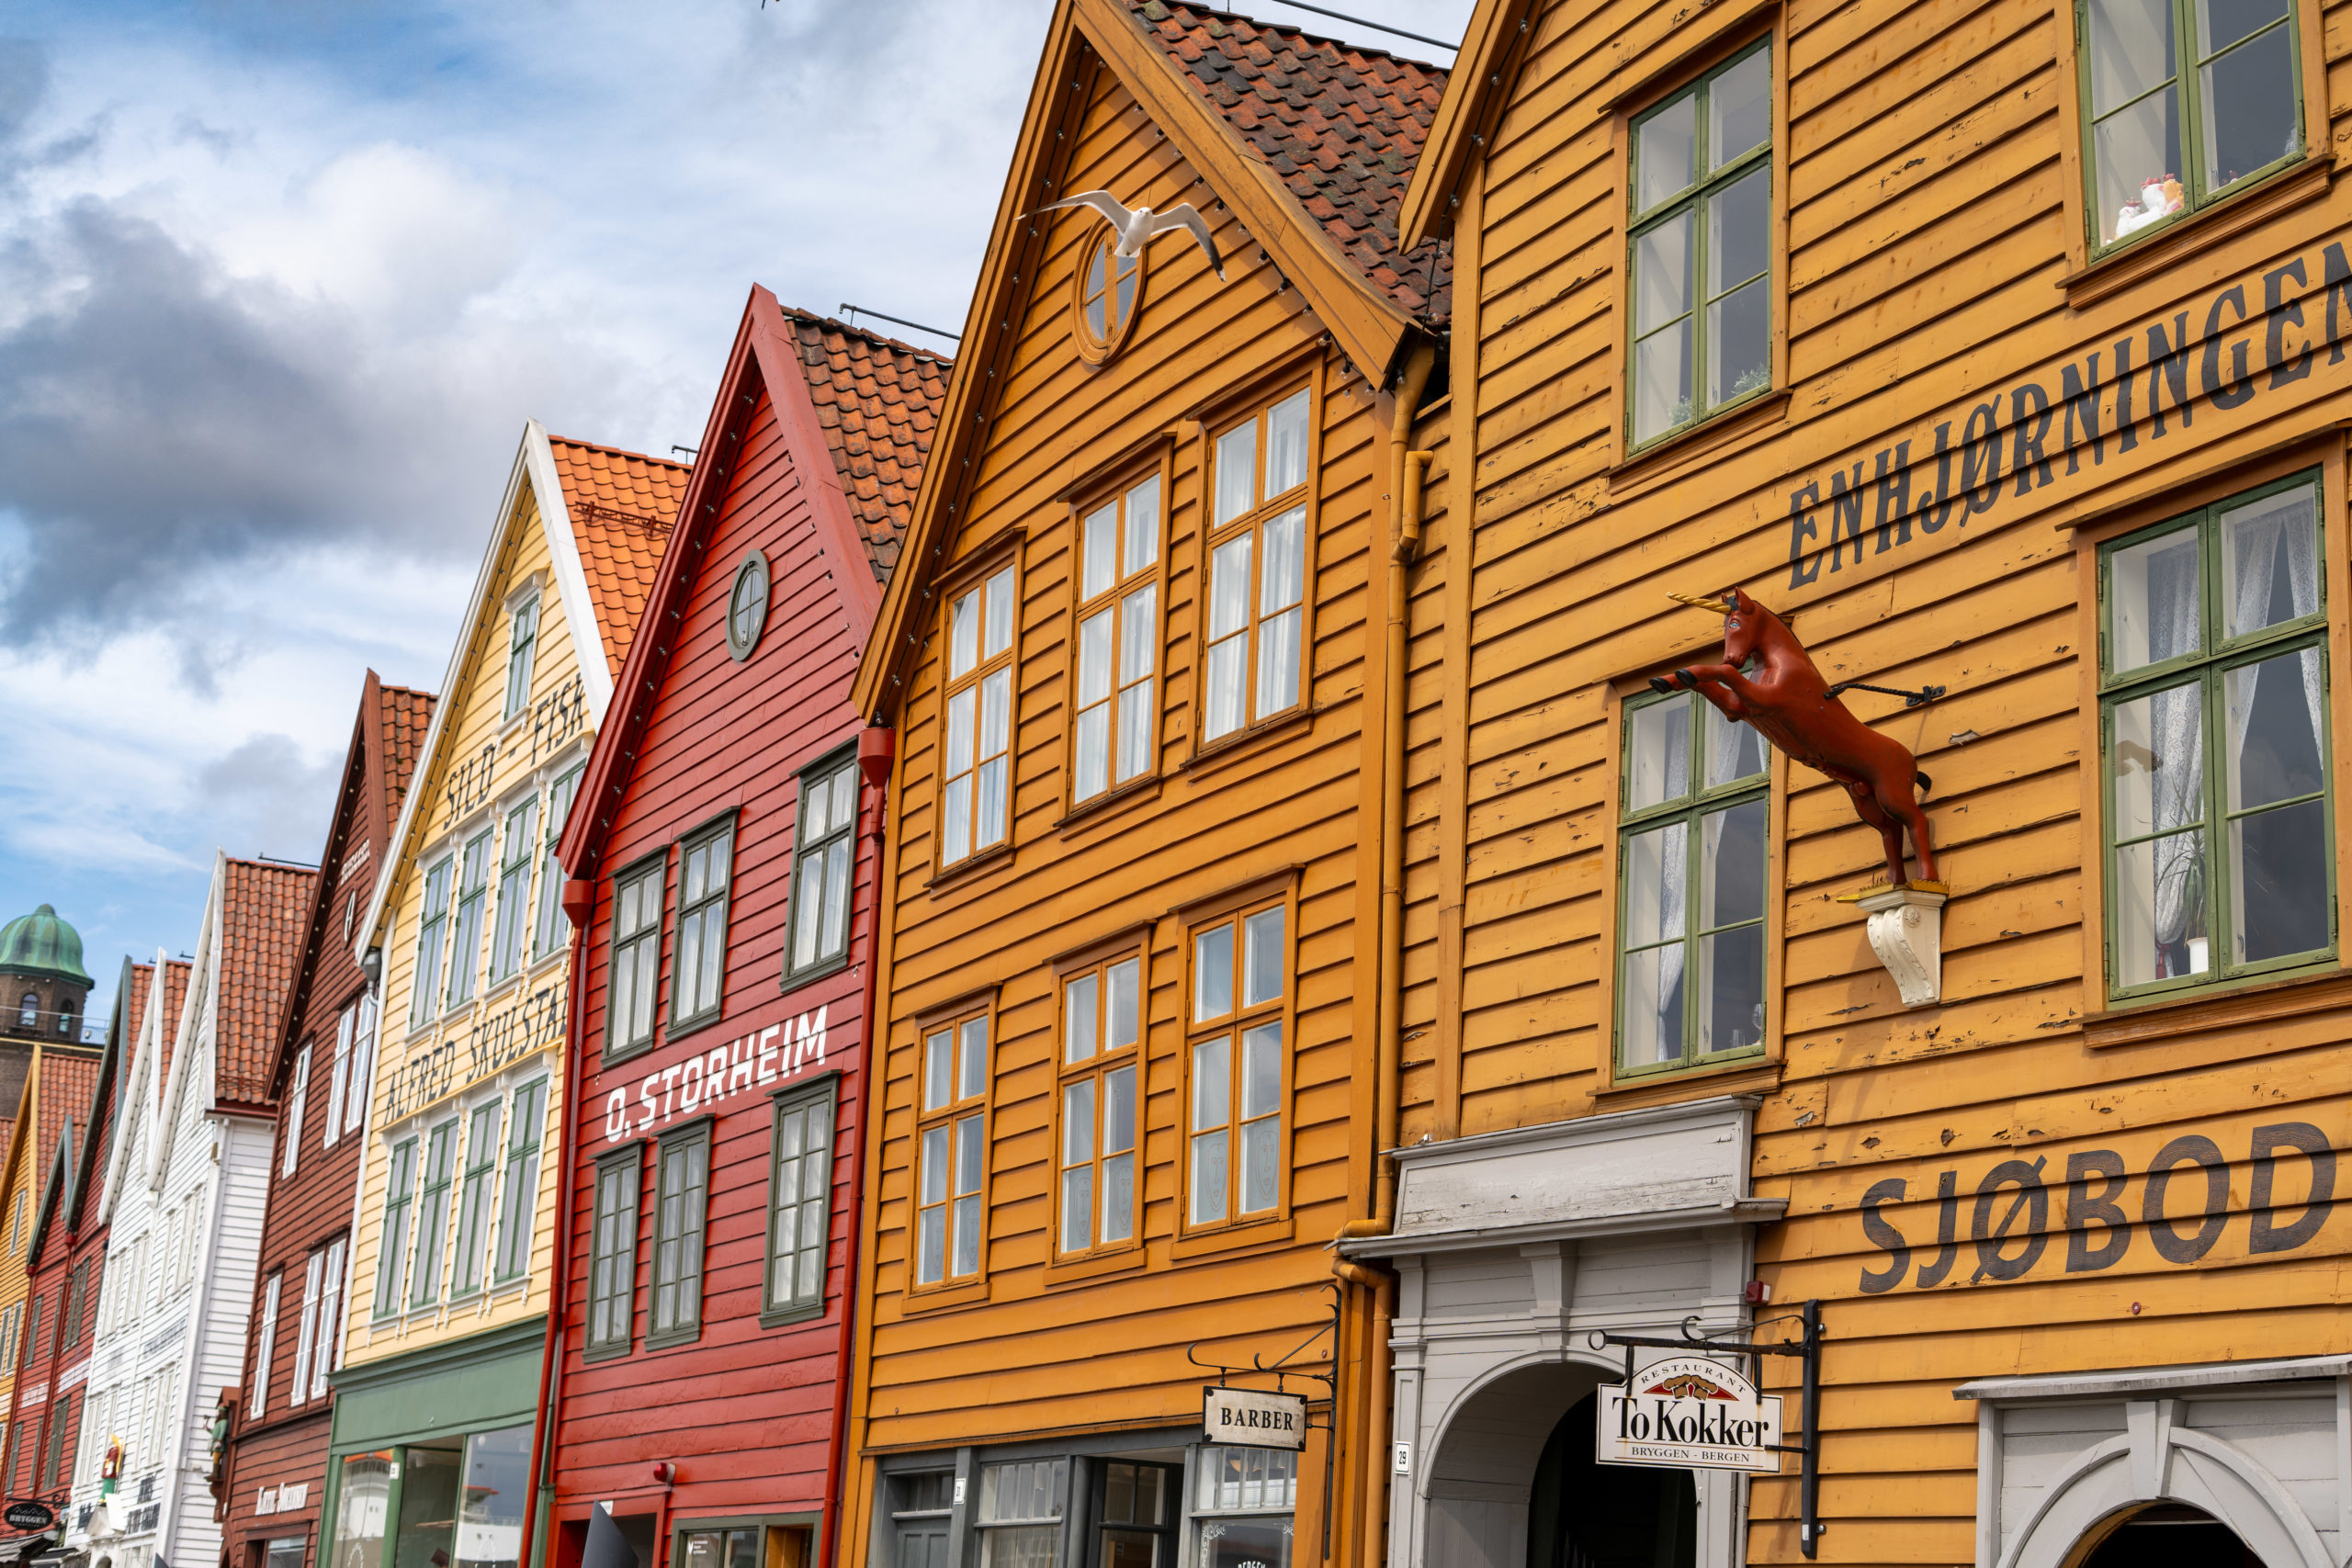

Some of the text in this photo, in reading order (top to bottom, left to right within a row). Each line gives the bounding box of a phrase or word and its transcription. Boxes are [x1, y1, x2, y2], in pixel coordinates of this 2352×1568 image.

[444, 743, 495, 830] SILD
[530, 672, 584, 768] FISK
[384, 1040, 456, 1125] ALFRED
[1860, 1122, 2338, 1294] SJØBOD
[1640, 1364, 1747, 1393] RESTAURANT
[1220, 1407, 1294, 1430] BARBER
[1612, 1396, 1770, 1448] To Kokker
[1398, 1450, 1407, 1464] 29
[1632, 1447, 1690, 1460] BRYGGEN
[1702, 1450, 1750, 1463] BERGEN
